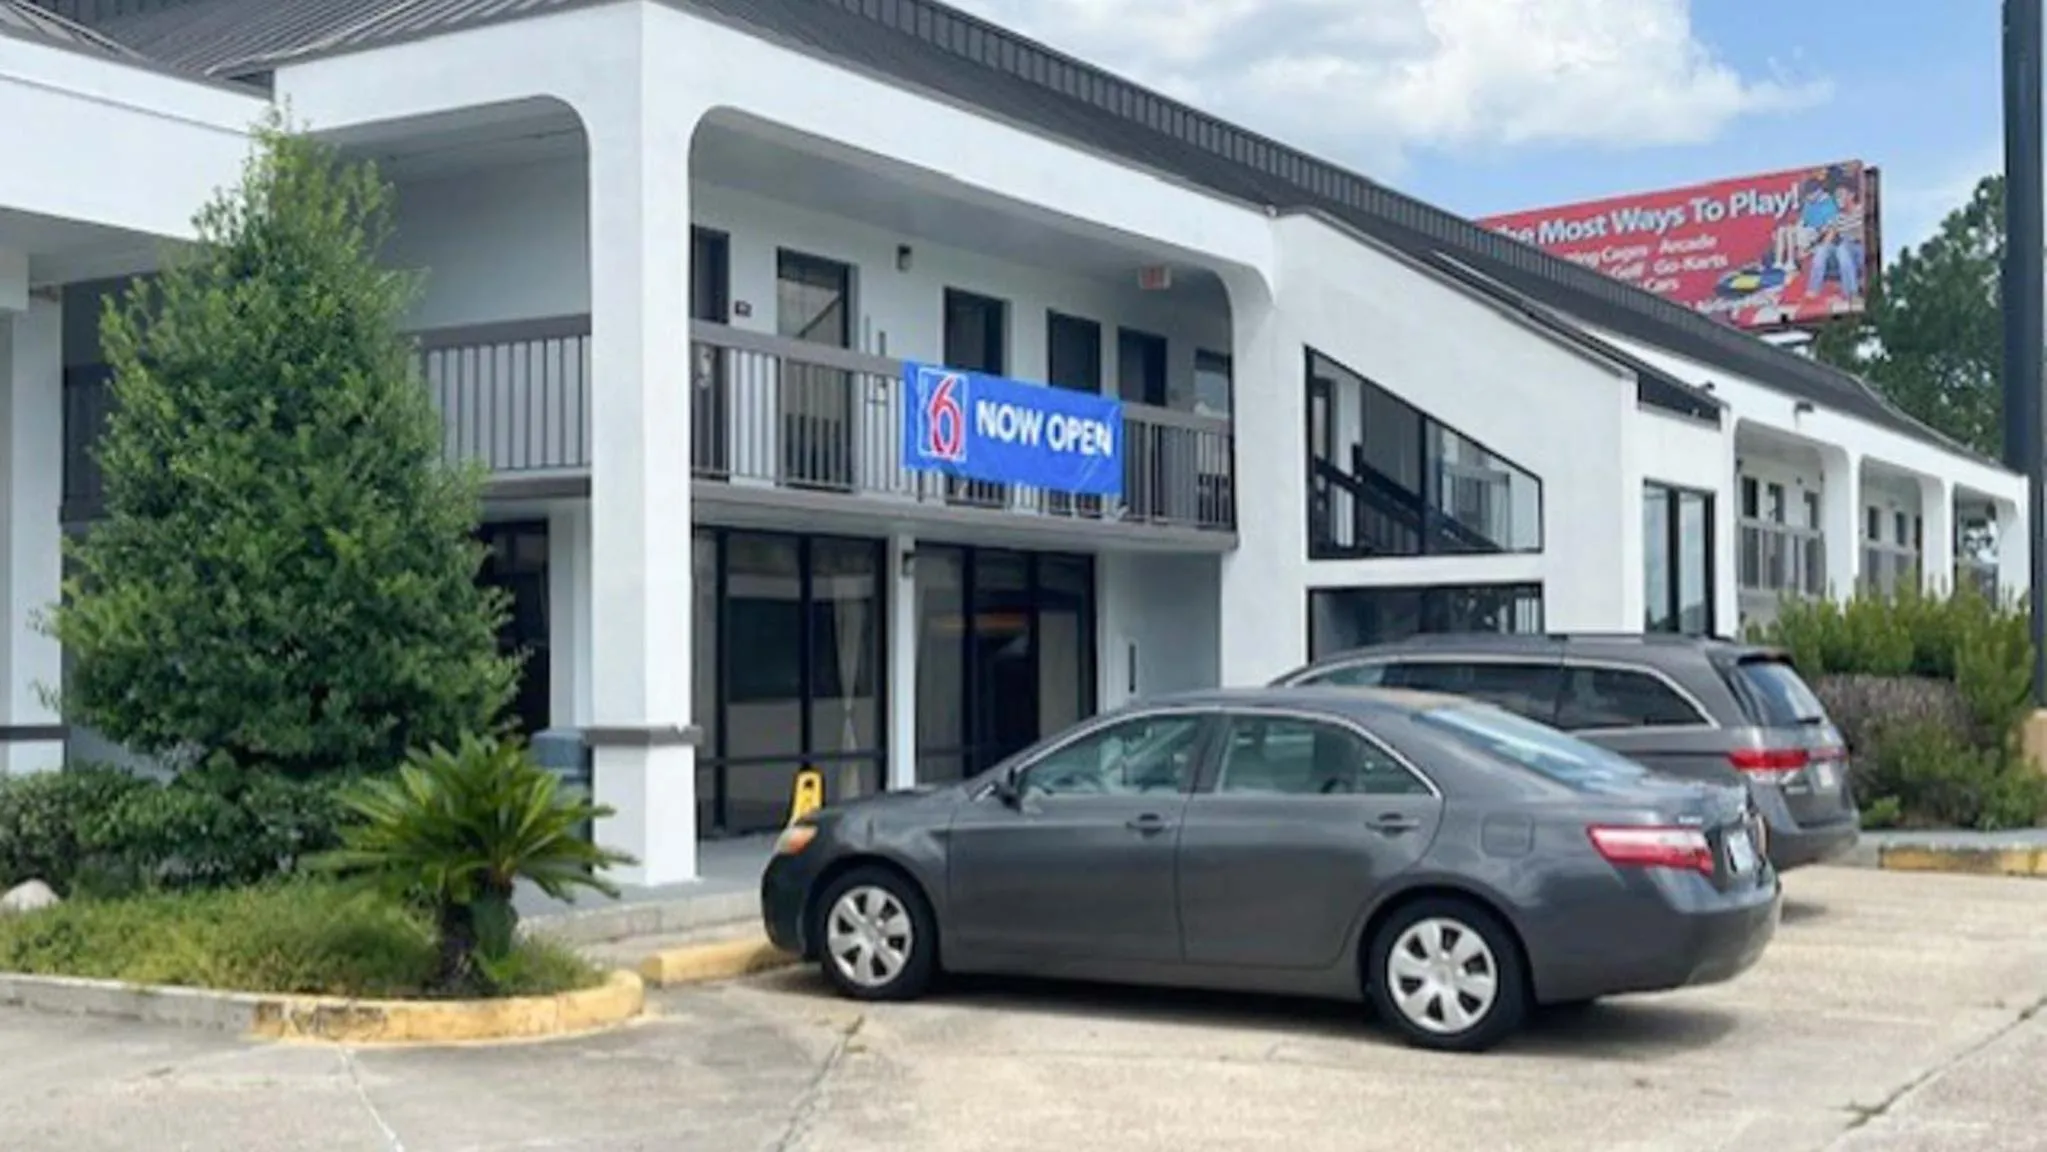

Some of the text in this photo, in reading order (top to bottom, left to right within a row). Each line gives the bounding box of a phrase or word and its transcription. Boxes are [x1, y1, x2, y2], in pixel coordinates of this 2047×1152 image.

[1494, 182, 1799, 246] he Most Ways To Play!
[1660, 234, 1718, 254] Arcade
[928, 374, 963, 460] 6
[976, 399, 1114, 458] NOW OPEN
